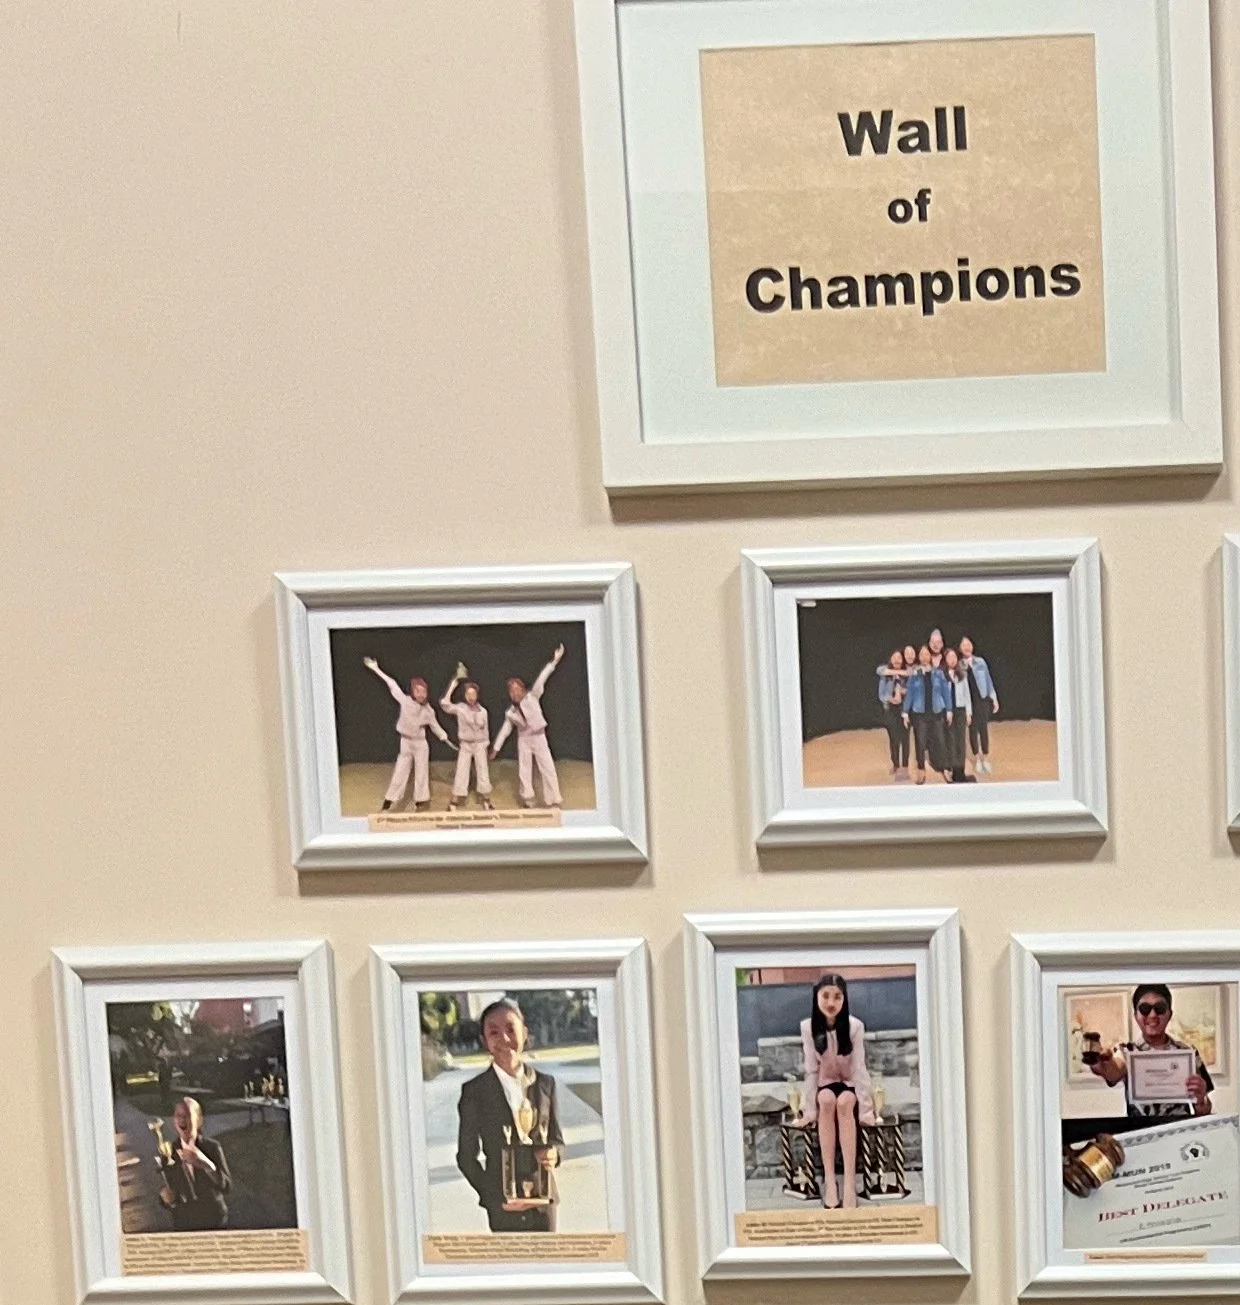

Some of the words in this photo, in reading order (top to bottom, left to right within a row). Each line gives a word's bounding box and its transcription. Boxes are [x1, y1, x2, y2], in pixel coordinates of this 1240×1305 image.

[838, 105, 969, 156] Wall
[888, 188, 932, 224] of
[745, 258, 1082, 316] Champions
